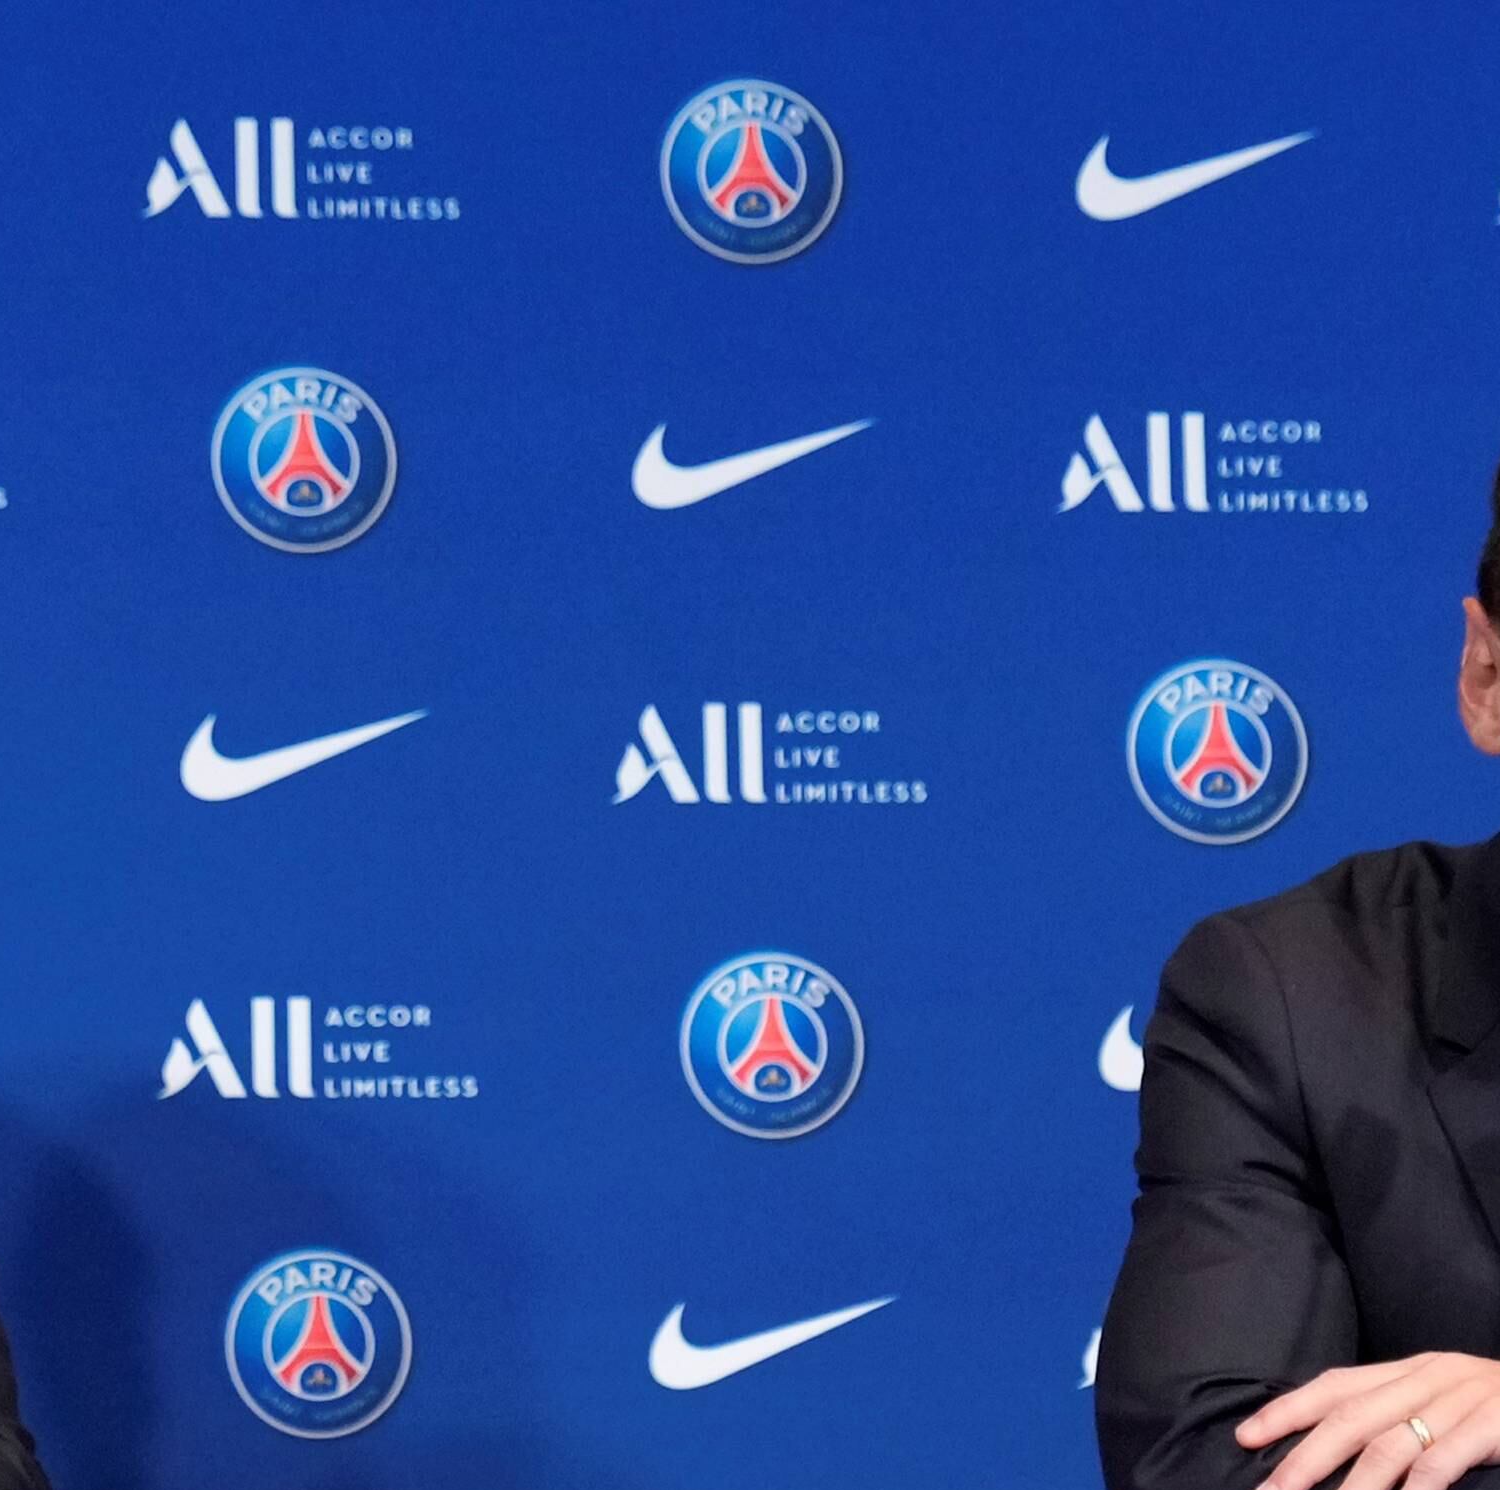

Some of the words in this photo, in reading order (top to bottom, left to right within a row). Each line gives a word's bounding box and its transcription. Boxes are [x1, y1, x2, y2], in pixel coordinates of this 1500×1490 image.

[690, 91, 809, 137] PARIS
[308, 127, 413, 150] ACCOR
[306, 162, 371, 185] LIVE
[307, 197, 461, 220] LIMITLESS
[242, 379, 362, 425] PARIS
[1219, 420, 1321, 443] ACCOR
[1217, 455, 1281, 478] LIVE
[1219, 489, 1369, 513] LIMITLESS
[1157, 671, 1274, 717] PARIS
[776, 711, 880, 734] ACCOR
[774, 746, 840, 769] LIVE
[775, 781, 928, 804] LIMITLESS
[710, 964, 829, 1010] PARIS
[324, 1004, 431, 1028] ACCOR
[323, 1040, 390, 1064] LIVE
[323, 1075, 479, 1099] LIMITLESS
[257, 1263, 378, 1309] PARIS
